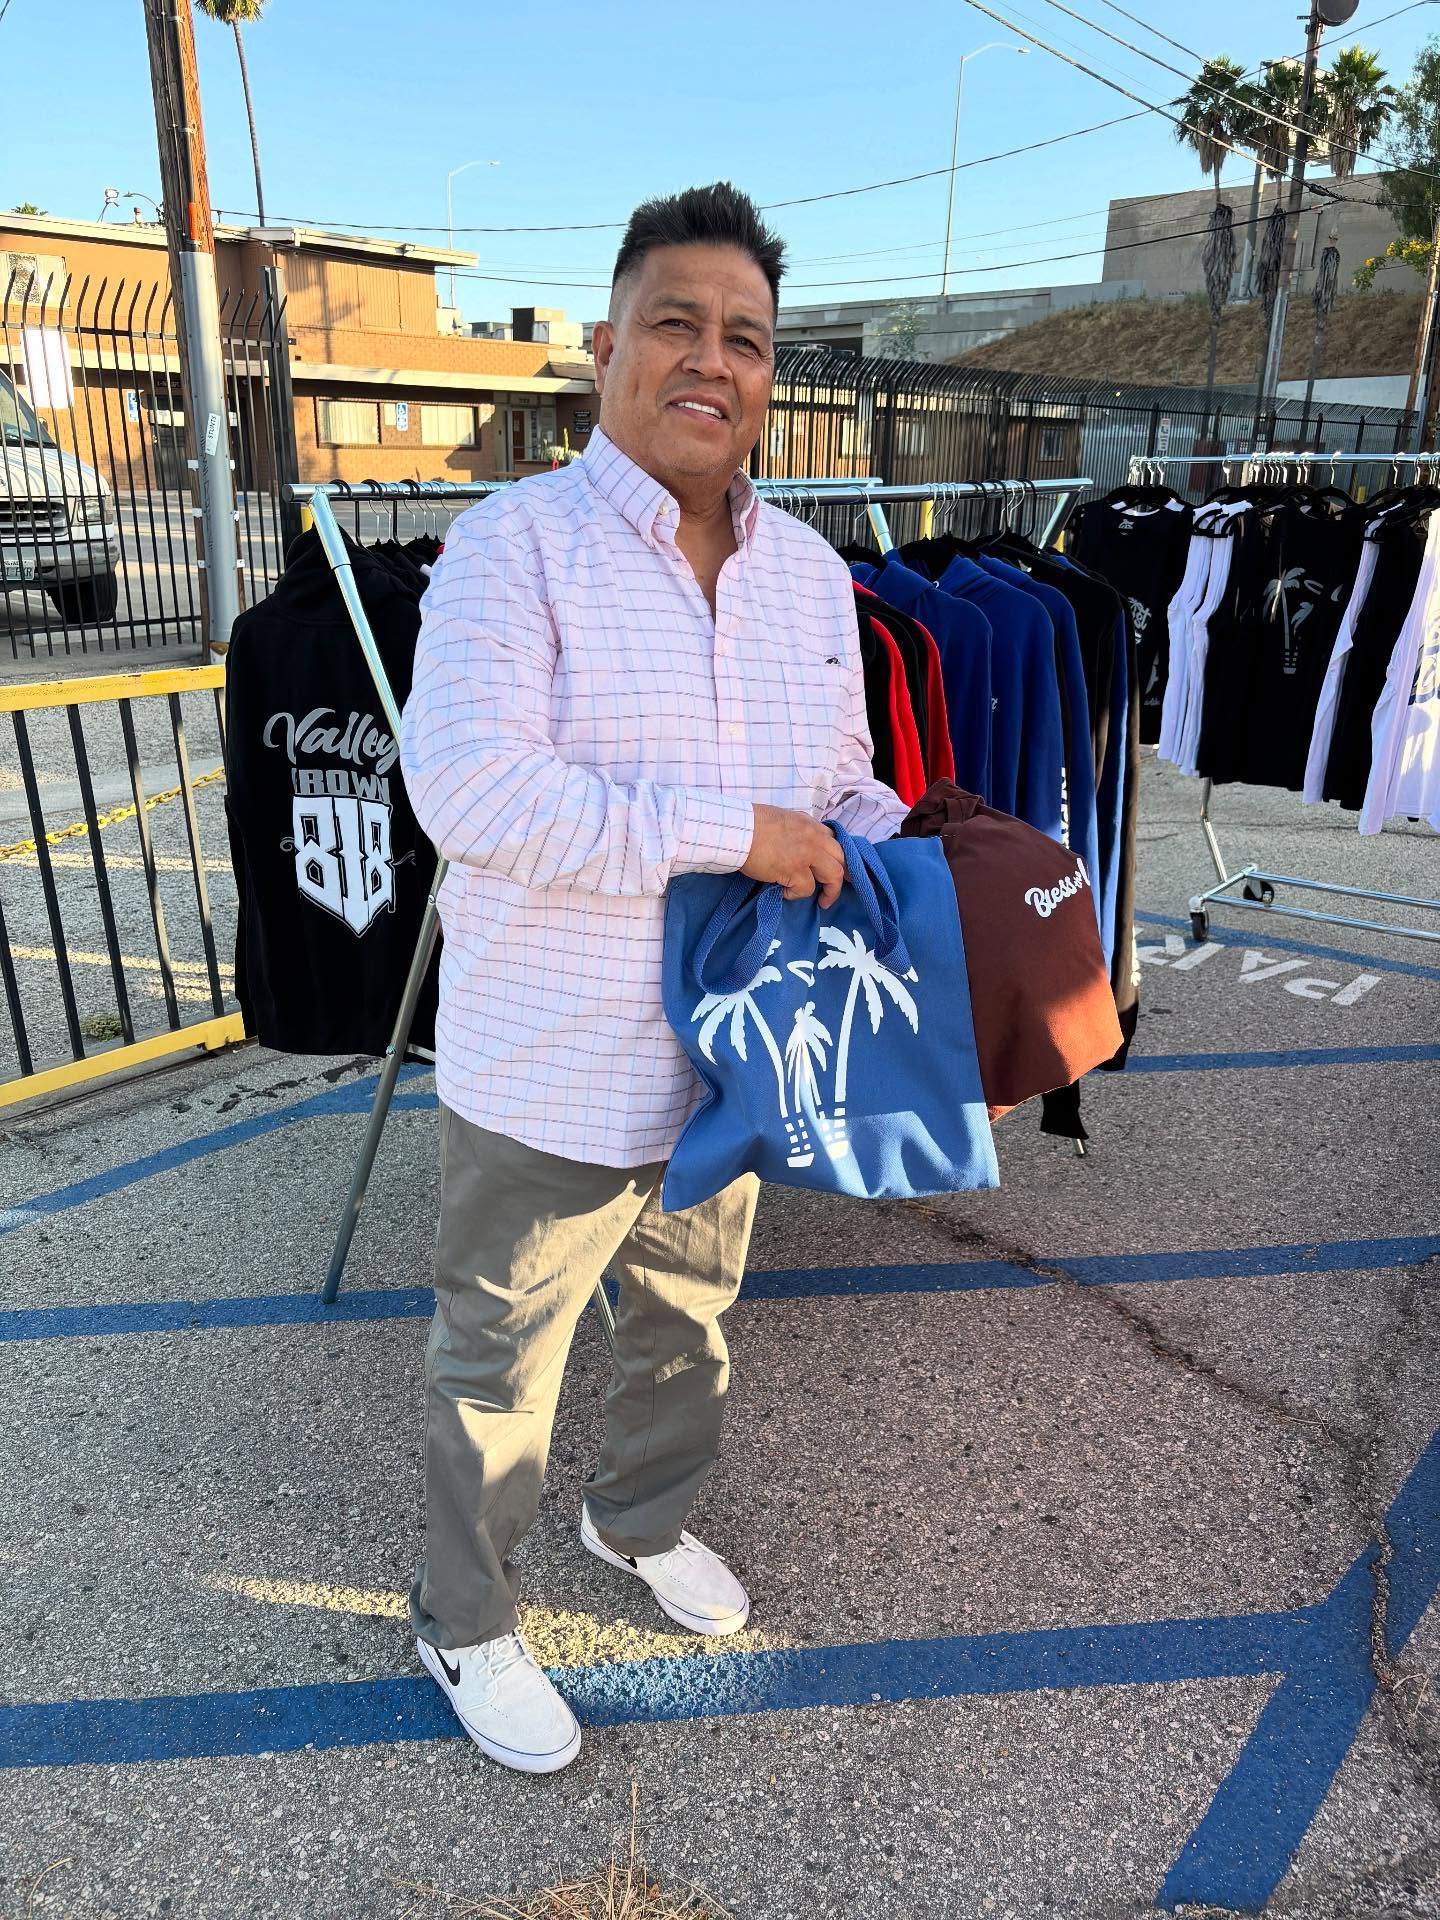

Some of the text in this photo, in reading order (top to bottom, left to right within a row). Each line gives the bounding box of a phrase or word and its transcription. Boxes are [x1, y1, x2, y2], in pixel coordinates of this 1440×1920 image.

[262, 707, 401, 774] Valley
[292, 767, 390, 804] ROWN
[292, 796, 396, 938] 818
